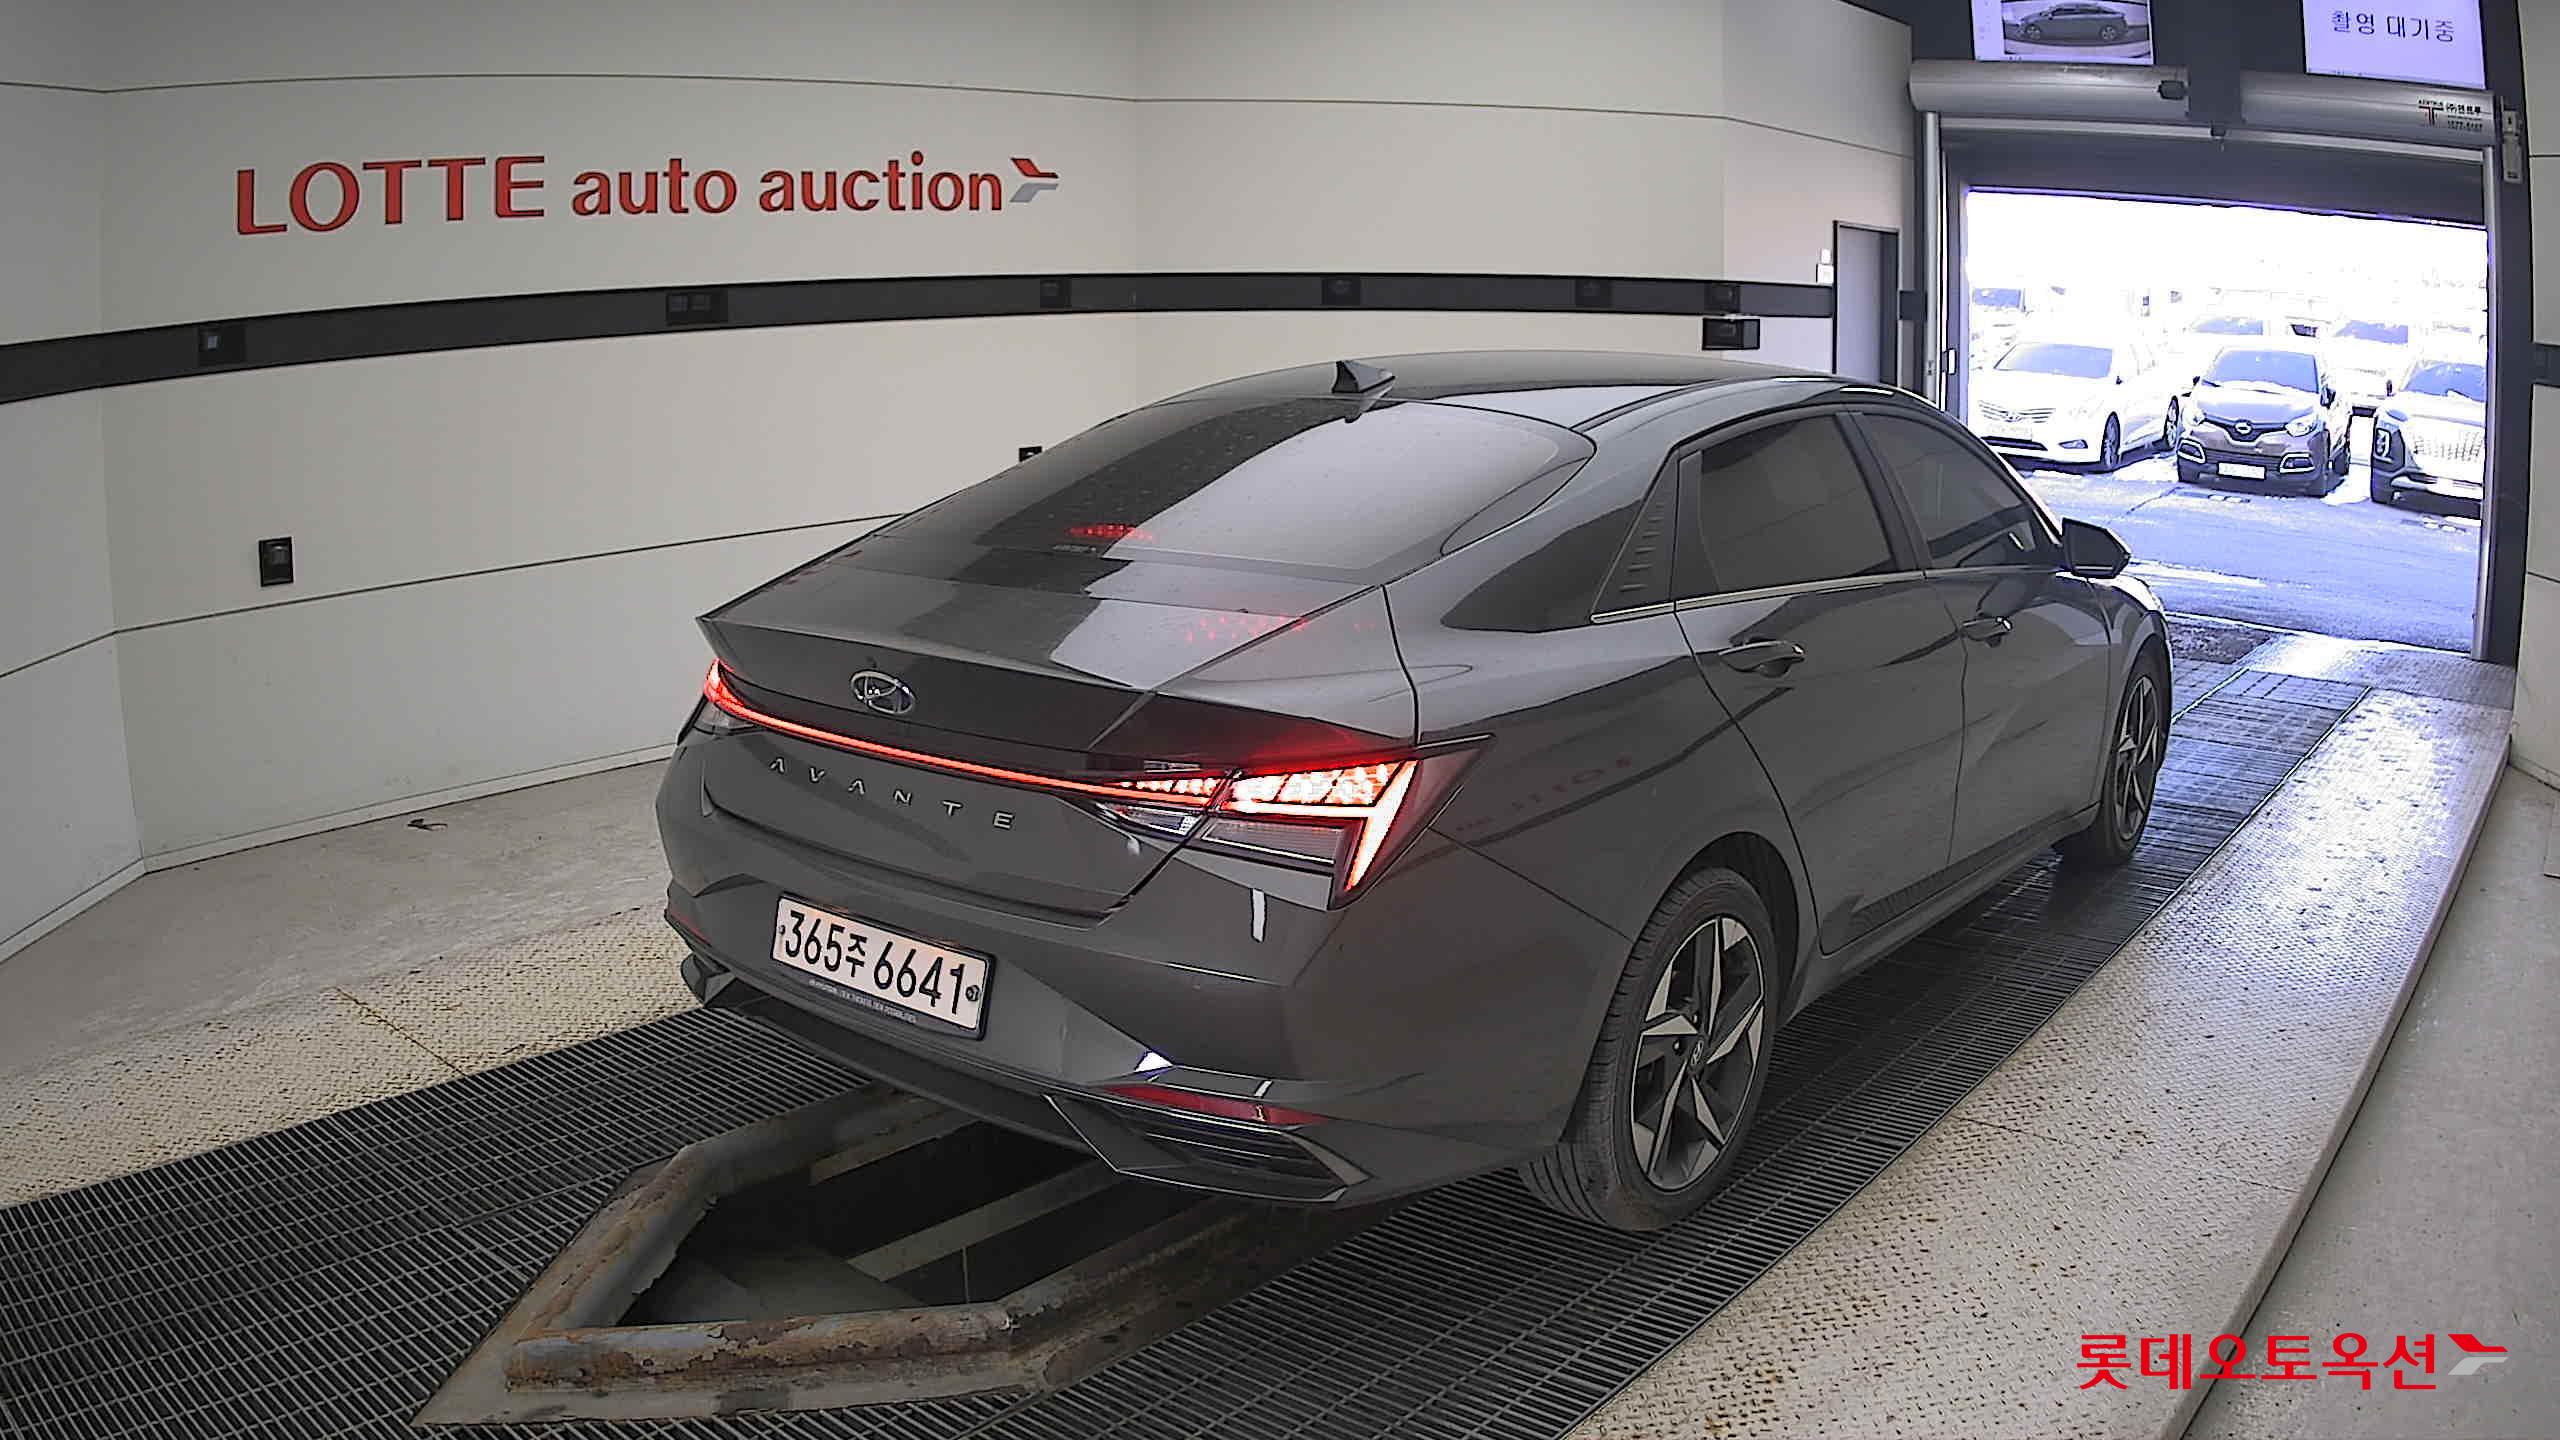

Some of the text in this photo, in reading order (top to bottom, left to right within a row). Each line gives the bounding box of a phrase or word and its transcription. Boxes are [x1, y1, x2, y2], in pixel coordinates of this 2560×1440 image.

[2331, 10, 2455, 43] 촬영 대기중
[237, 151, 1003, 236] LOTTE auto auction
[769, 756, 1014, 830] AVANTE
[784, 909, 868, 978] 365주
[873, 940, 966, 1015] 6641
